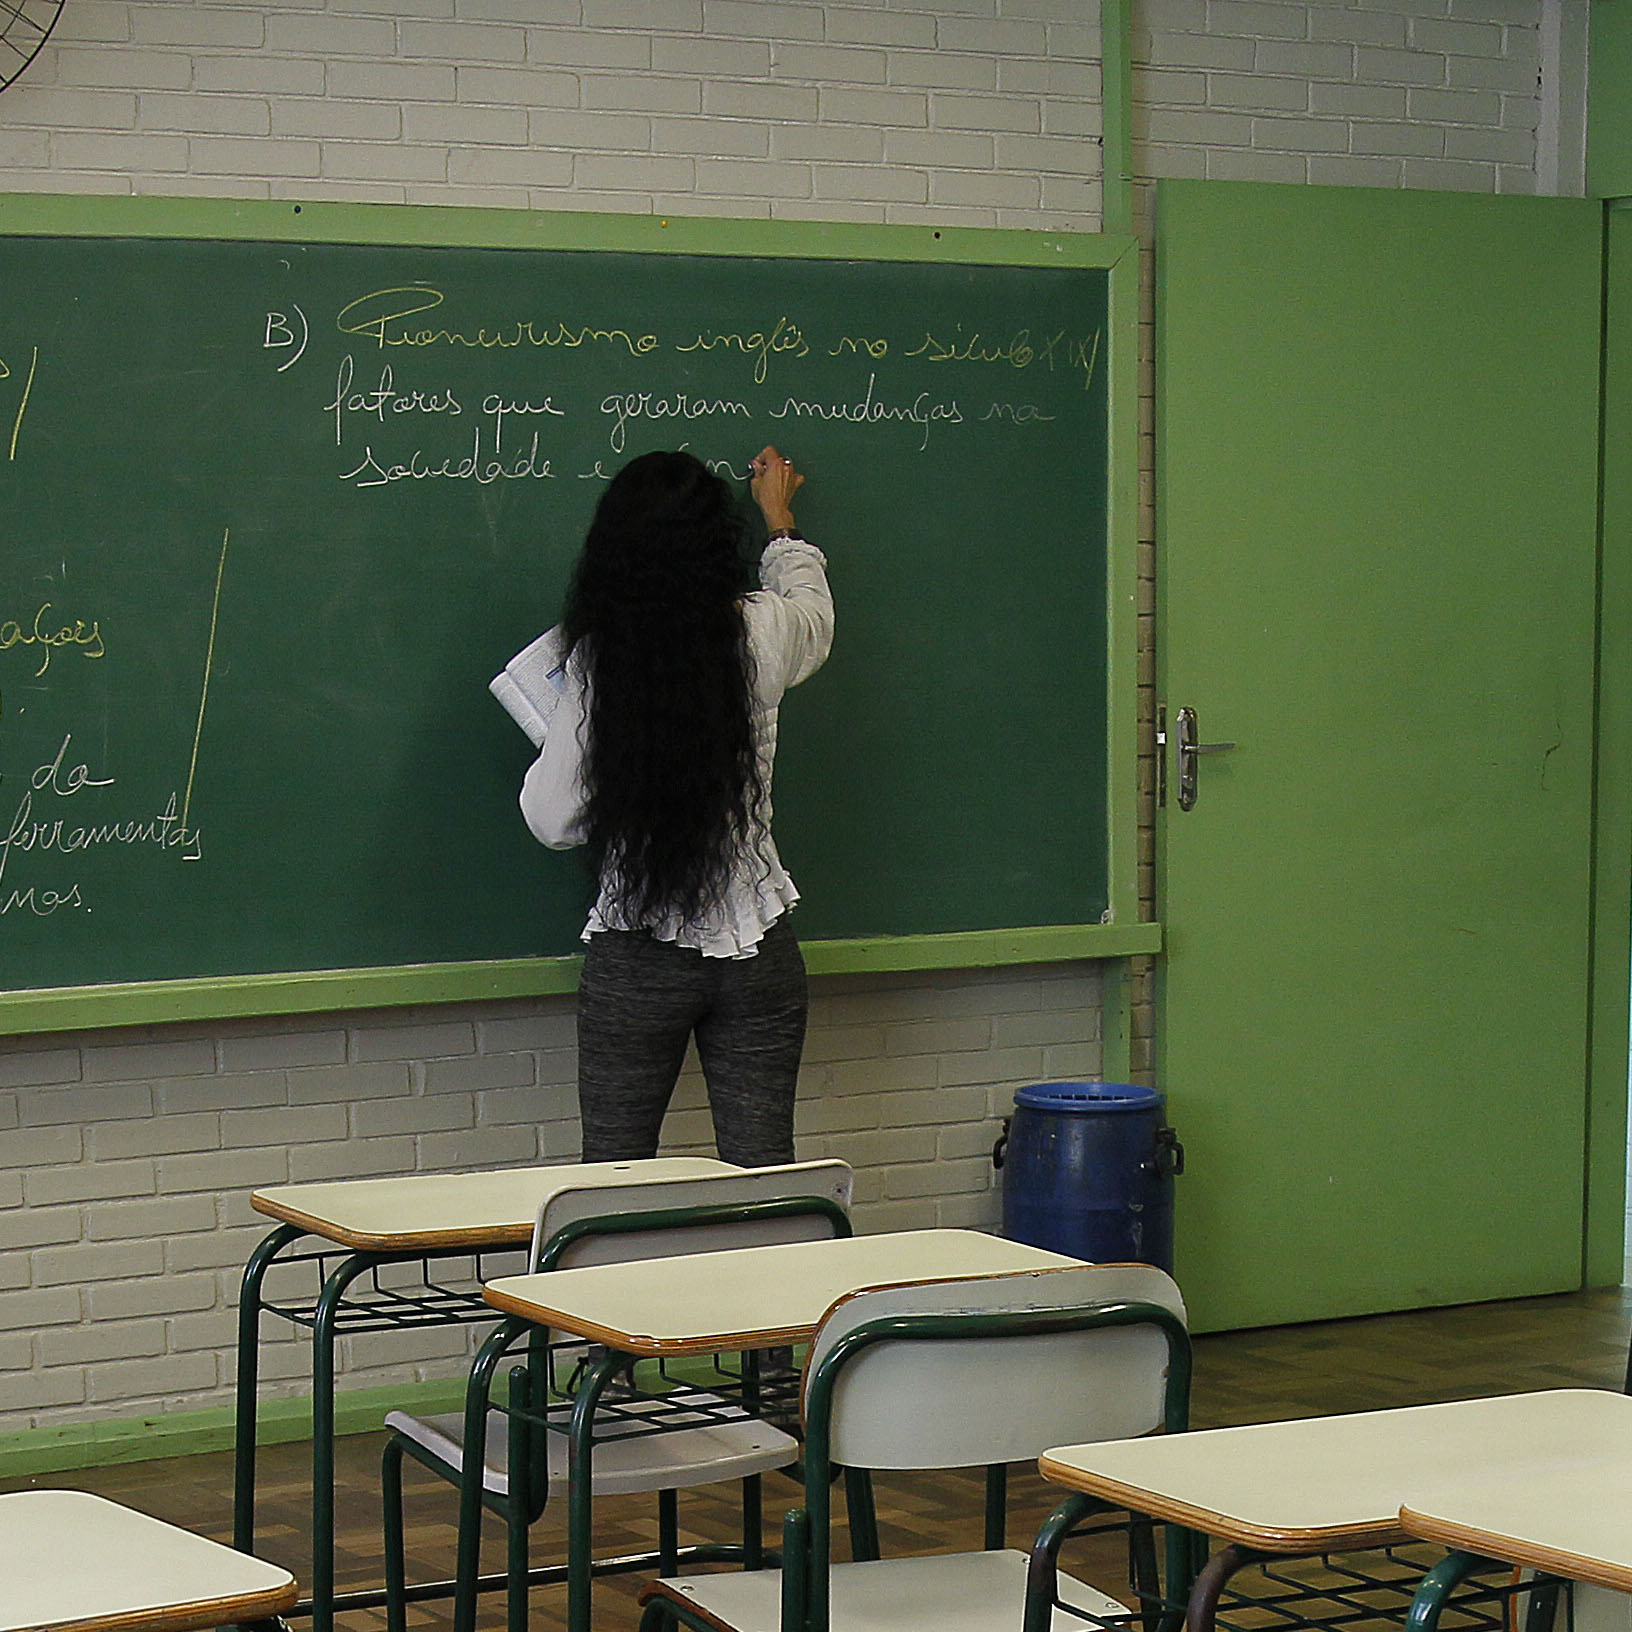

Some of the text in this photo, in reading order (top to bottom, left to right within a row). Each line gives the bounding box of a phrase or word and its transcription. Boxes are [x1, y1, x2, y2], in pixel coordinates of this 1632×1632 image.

[263, 304, 308, 372] B)
[828, 335, 887, 358] no
[324, 354, 462, 446] fatores
[483, 393, 564, 454] que
[600, 392, 752, 453] geraram
[978, 402, 1056, 425] na
